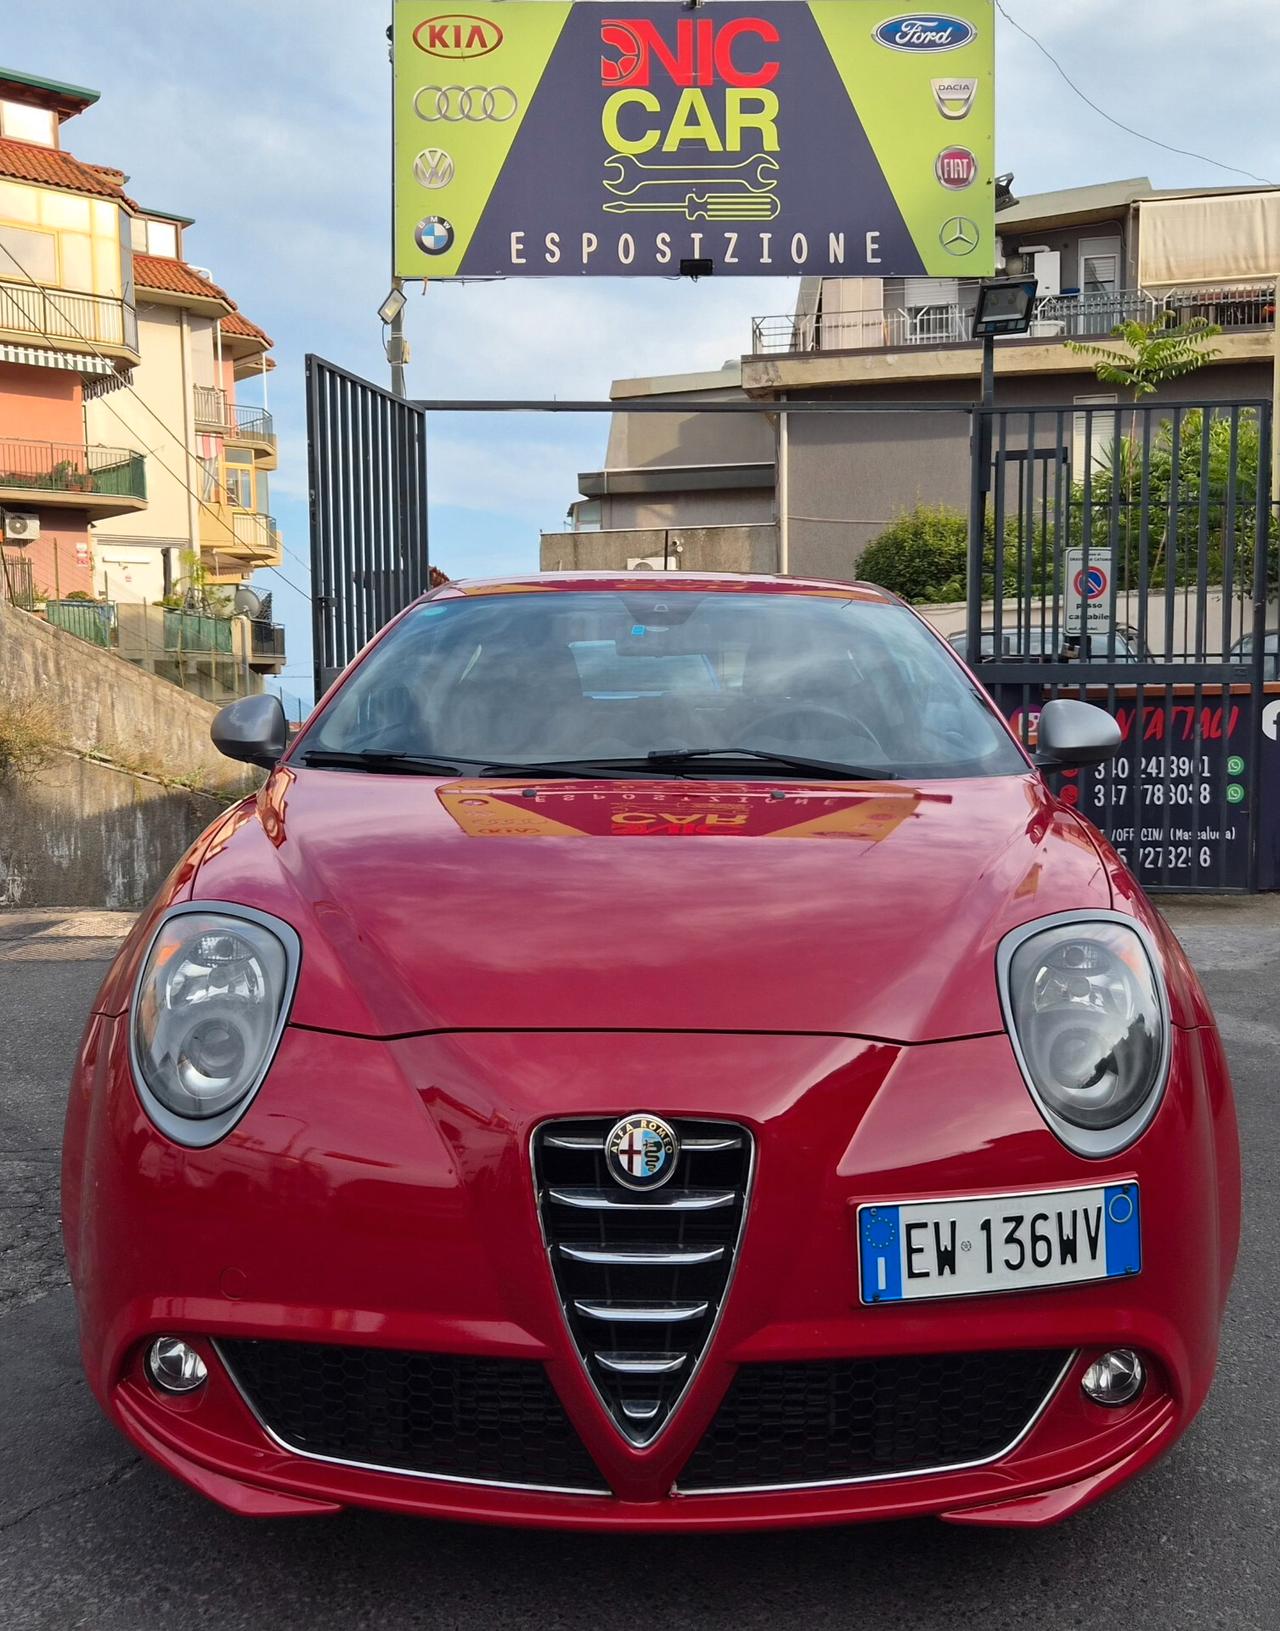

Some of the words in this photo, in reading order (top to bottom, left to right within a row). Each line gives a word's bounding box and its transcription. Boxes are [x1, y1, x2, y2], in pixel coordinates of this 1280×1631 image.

[428, 24, 488, 49] KIA
[894, 20, 953, 46] Ford
[643, 17, 781, 87] NIC
[938, 83, 971, 92] DACIA
[601, 88, 780, 153] CAR
[943, 158, 969, 179] FIAT
[509, 230, 882, 264] ESPOSIZIONE
[1068, 612, 1109, 620] caabile
[610, 1123, 634, 1153] ALFA
[640, 1120, 673, 1154] ROMEO
